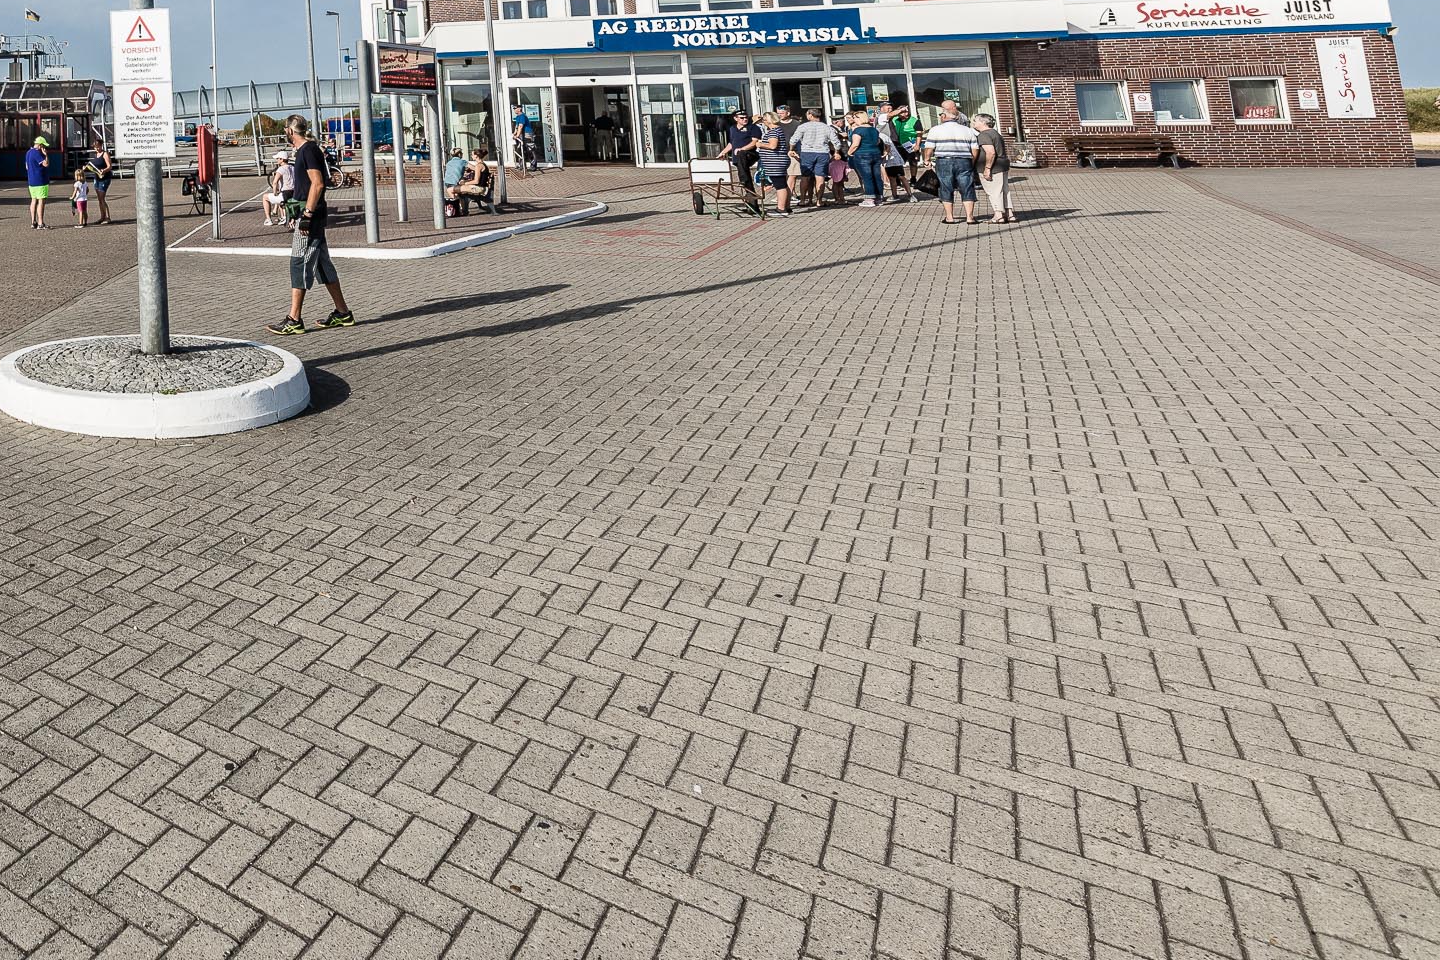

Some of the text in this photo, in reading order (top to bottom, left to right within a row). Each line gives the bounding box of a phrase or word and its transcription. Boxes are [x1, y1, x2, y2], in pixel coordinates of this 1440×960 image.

[1136, 2, 1271, 23] Servicestelle
[1283, 0, 1332, 13] JUIST
[1146, 18, 1262, 29] KURVERWALTUNG
[1285, 13, 1335, 21] TÖWERLAND
[597, 15, 750, 35] AG REEDEREI
[671, 26, 859, 48] NORDEN-FRISIA
[1328, 38, 1349, 46] JUIST
[121, 46, 161, 54] VORSICHT!
[1335, 50, 1356, 102] Service
